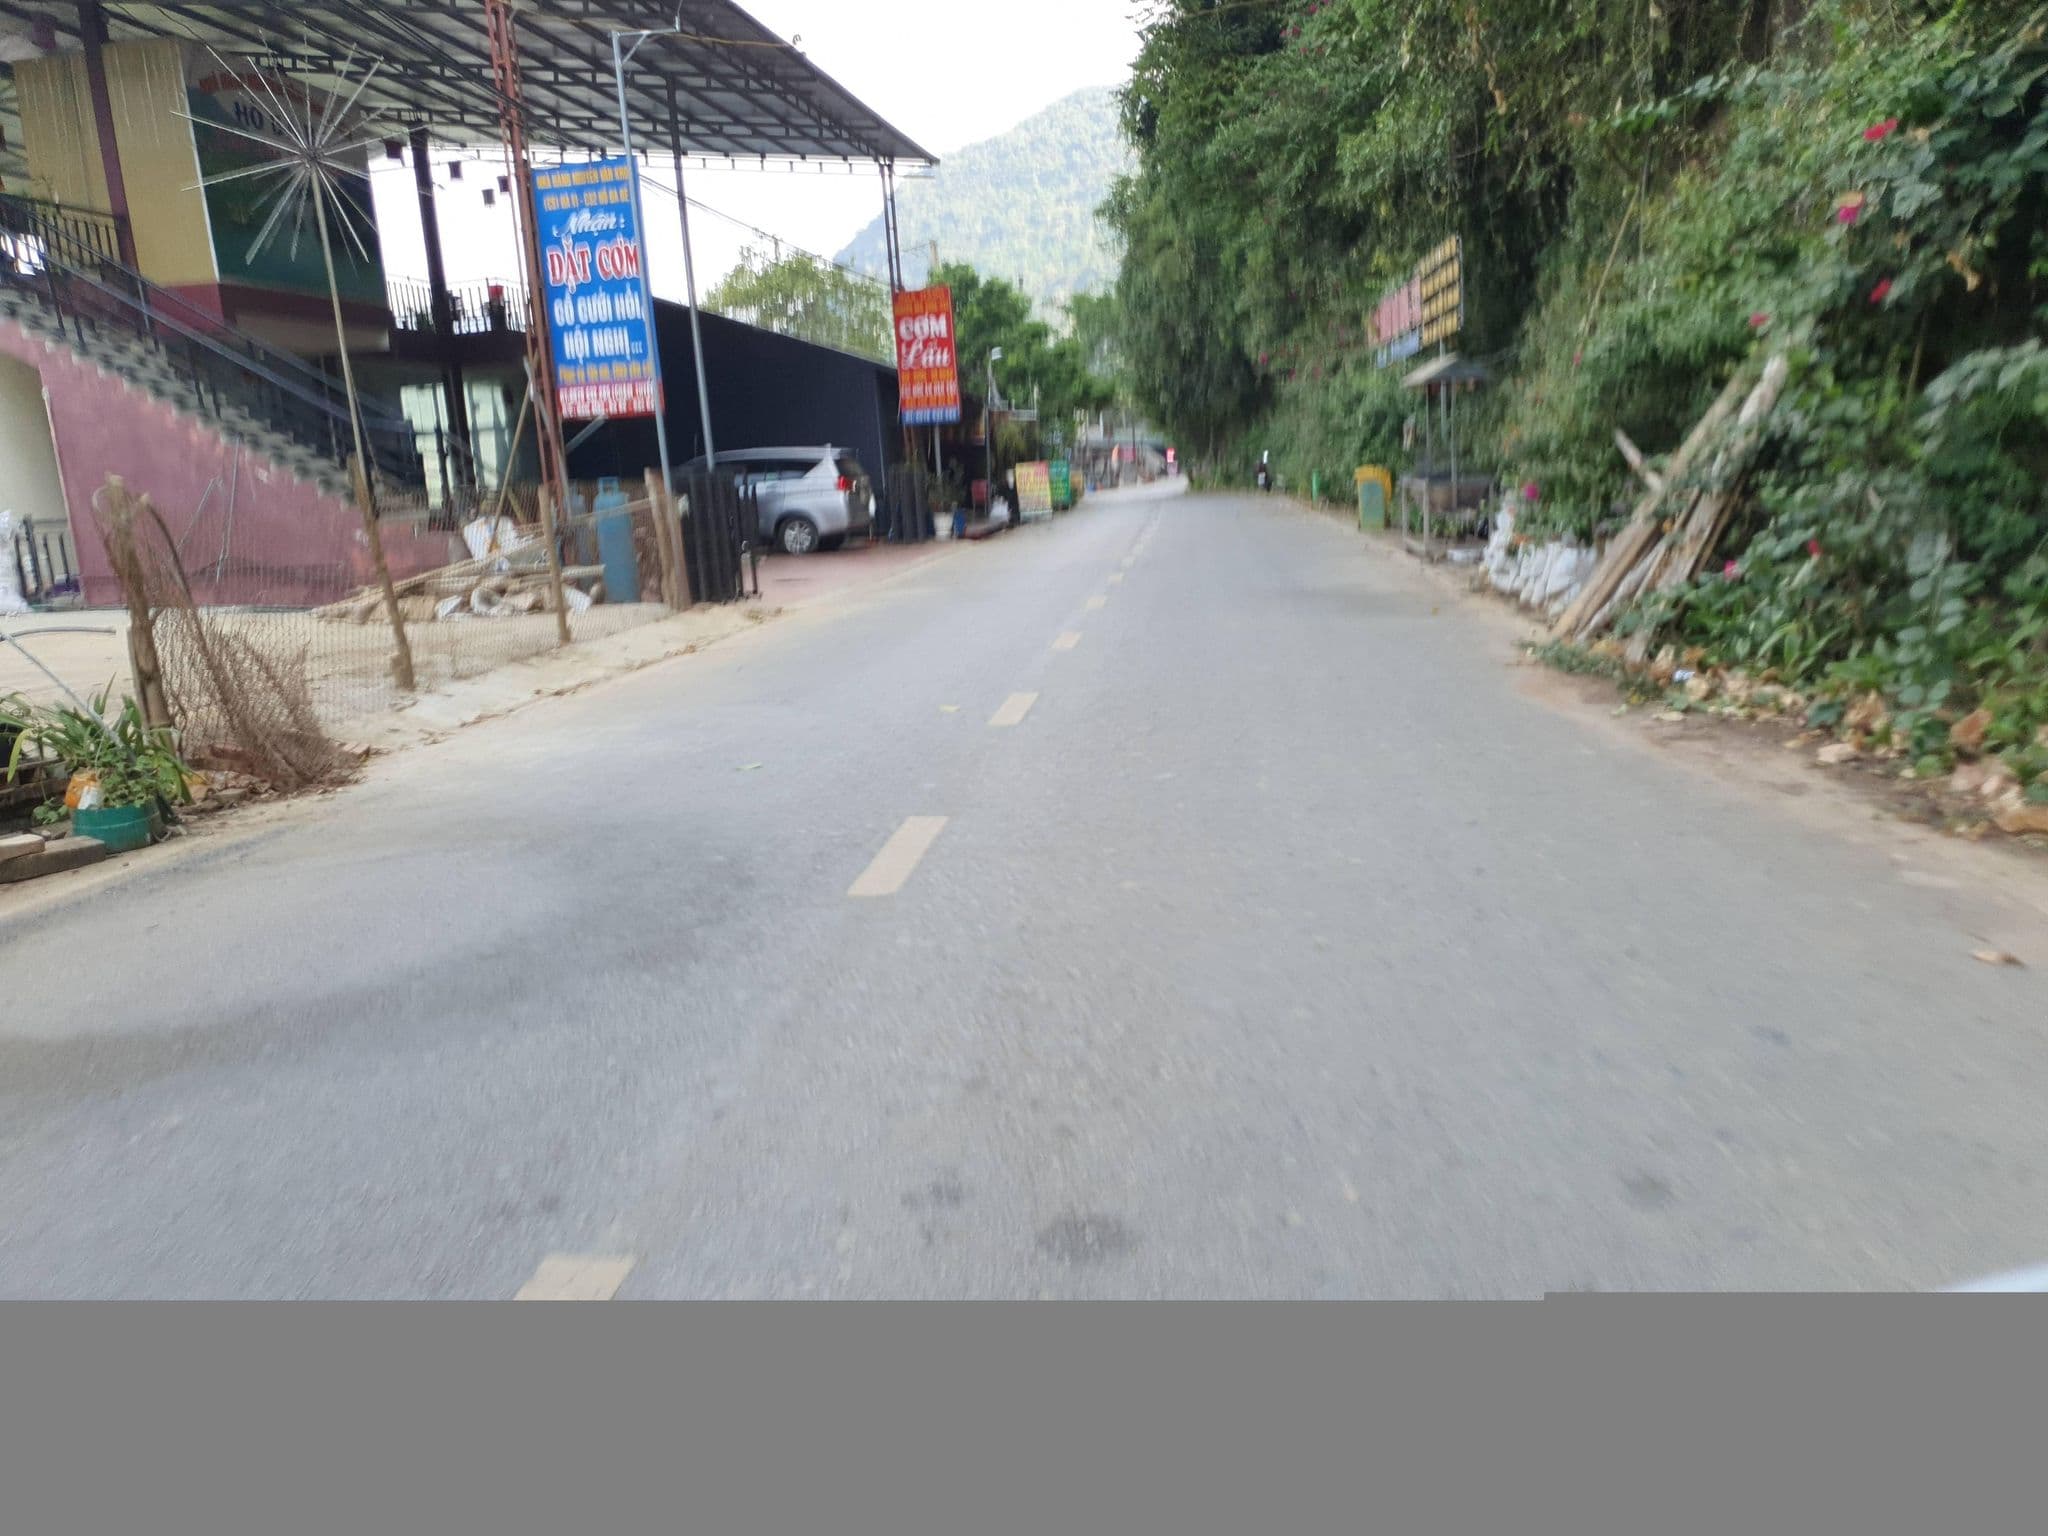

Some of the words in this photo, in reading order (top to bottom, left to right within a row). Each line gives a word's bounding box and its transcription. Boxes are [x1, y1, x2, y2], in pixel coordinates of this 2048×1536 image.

[596, 231, 641, 281] CƠM
[563, 324, 590, 365] HỘI
[899, 312, 948, 342] CƠM
